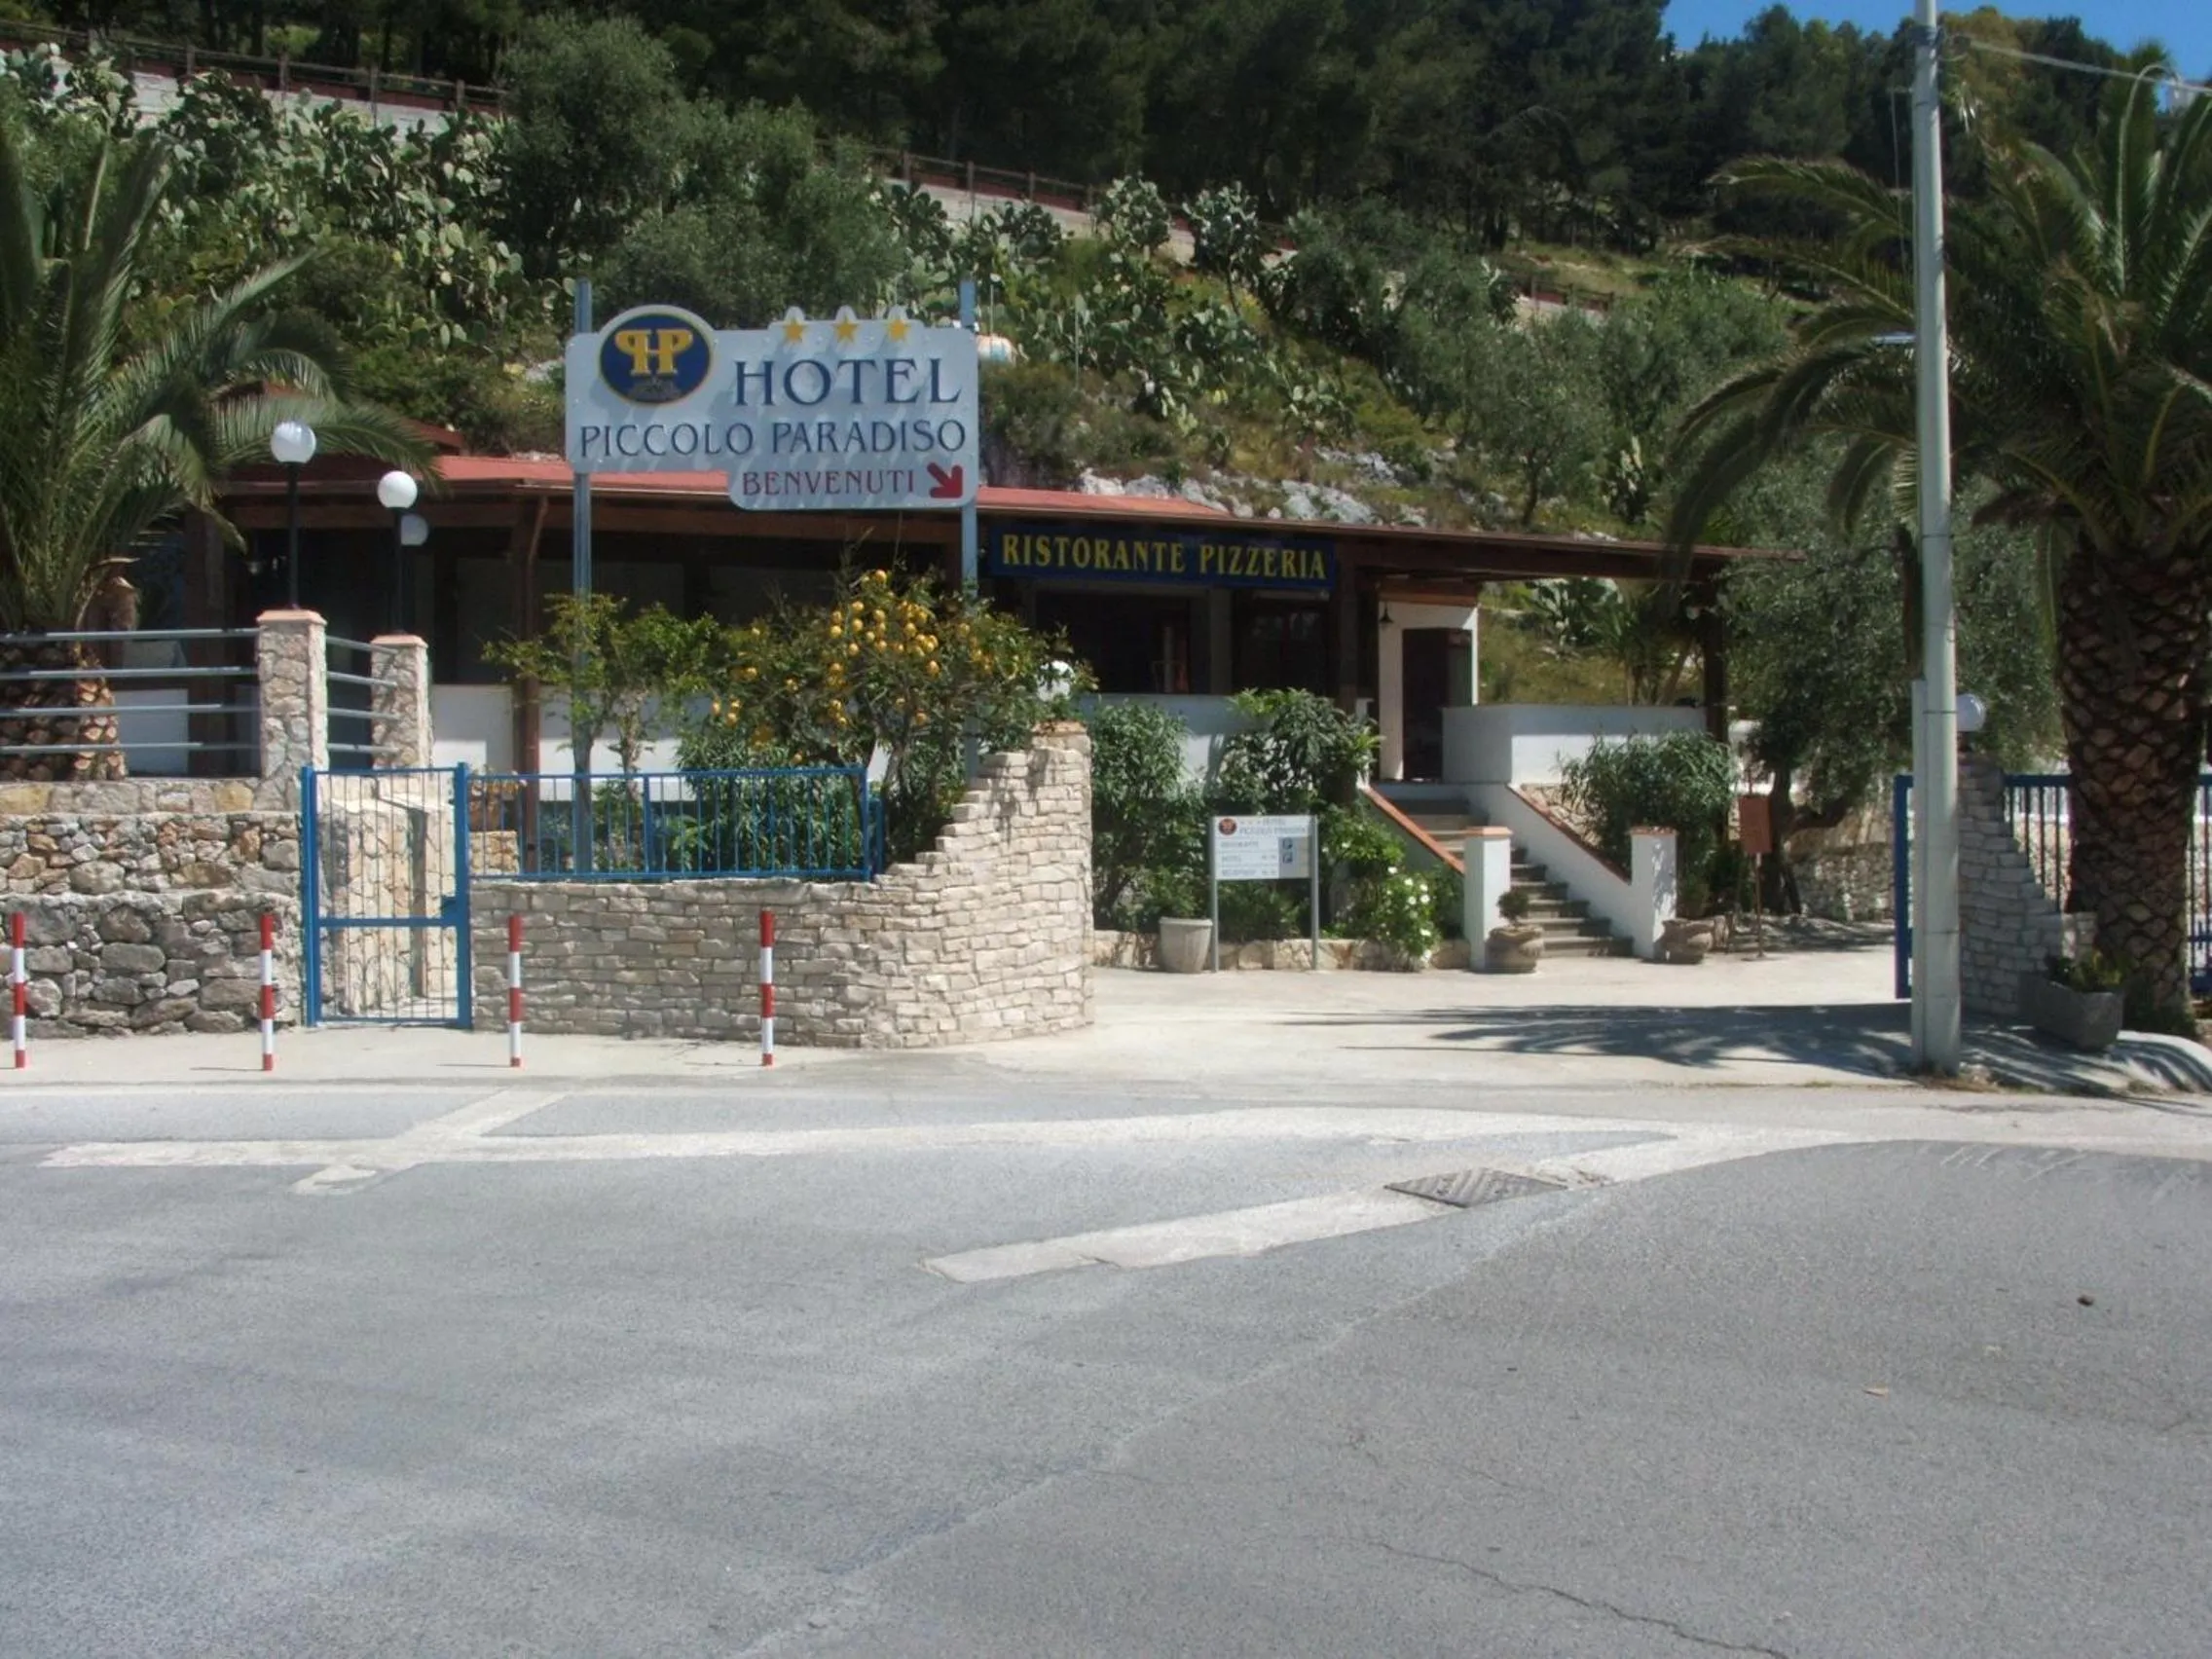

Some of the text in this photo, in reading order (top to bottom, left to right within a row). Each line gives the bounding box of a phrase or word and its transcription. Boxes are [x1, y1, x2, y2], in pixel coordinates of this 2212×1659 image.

[734, 358, 962, 407] HOTEL
[580, 420, 966, 457] PICCOLO PARADISO
[743, 470, 914, 497] BENVENUTI
[1002, 535, 1327, 580] RISTORANTE PIZZERIA
